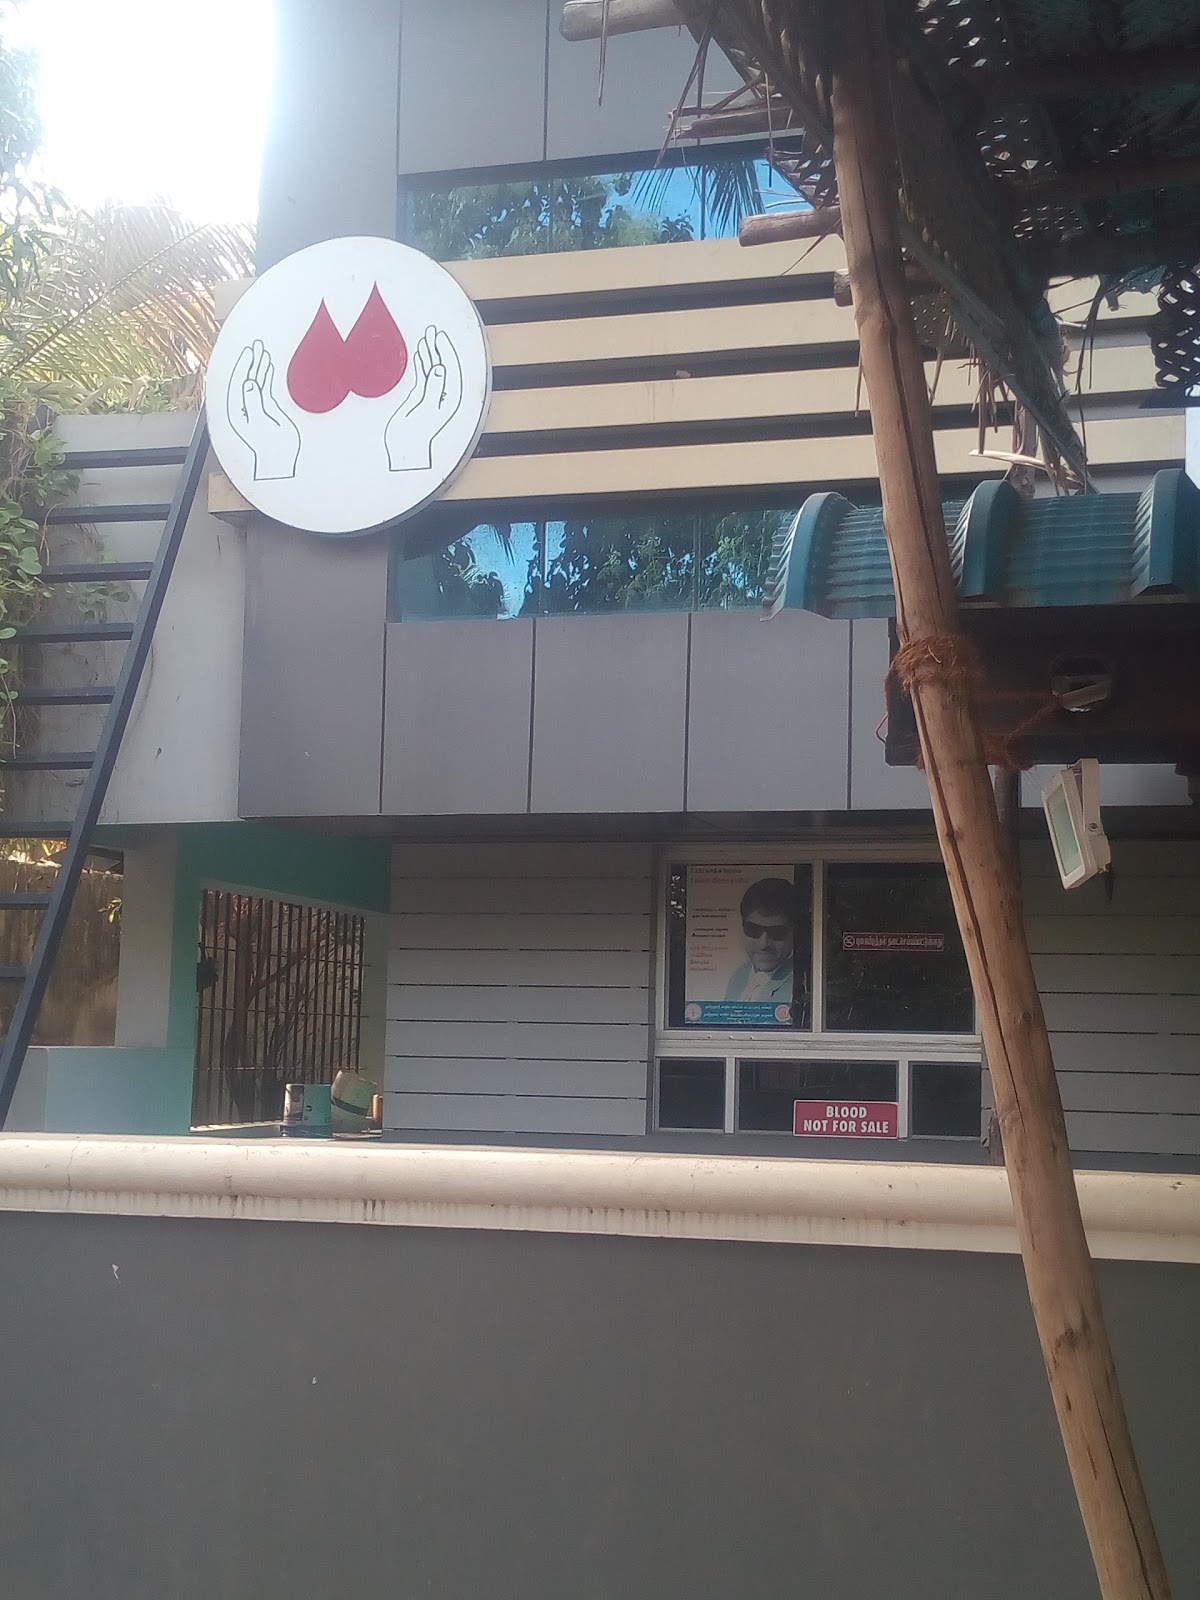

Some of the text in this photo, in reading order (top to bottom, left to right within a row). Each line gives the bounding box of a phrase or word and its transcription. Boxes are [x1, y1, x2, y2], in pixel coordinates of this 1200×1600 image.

[826, 1106, 867, 1118] BLOOD
[803, 1119, 889, 1133] NOT FOR SALE
